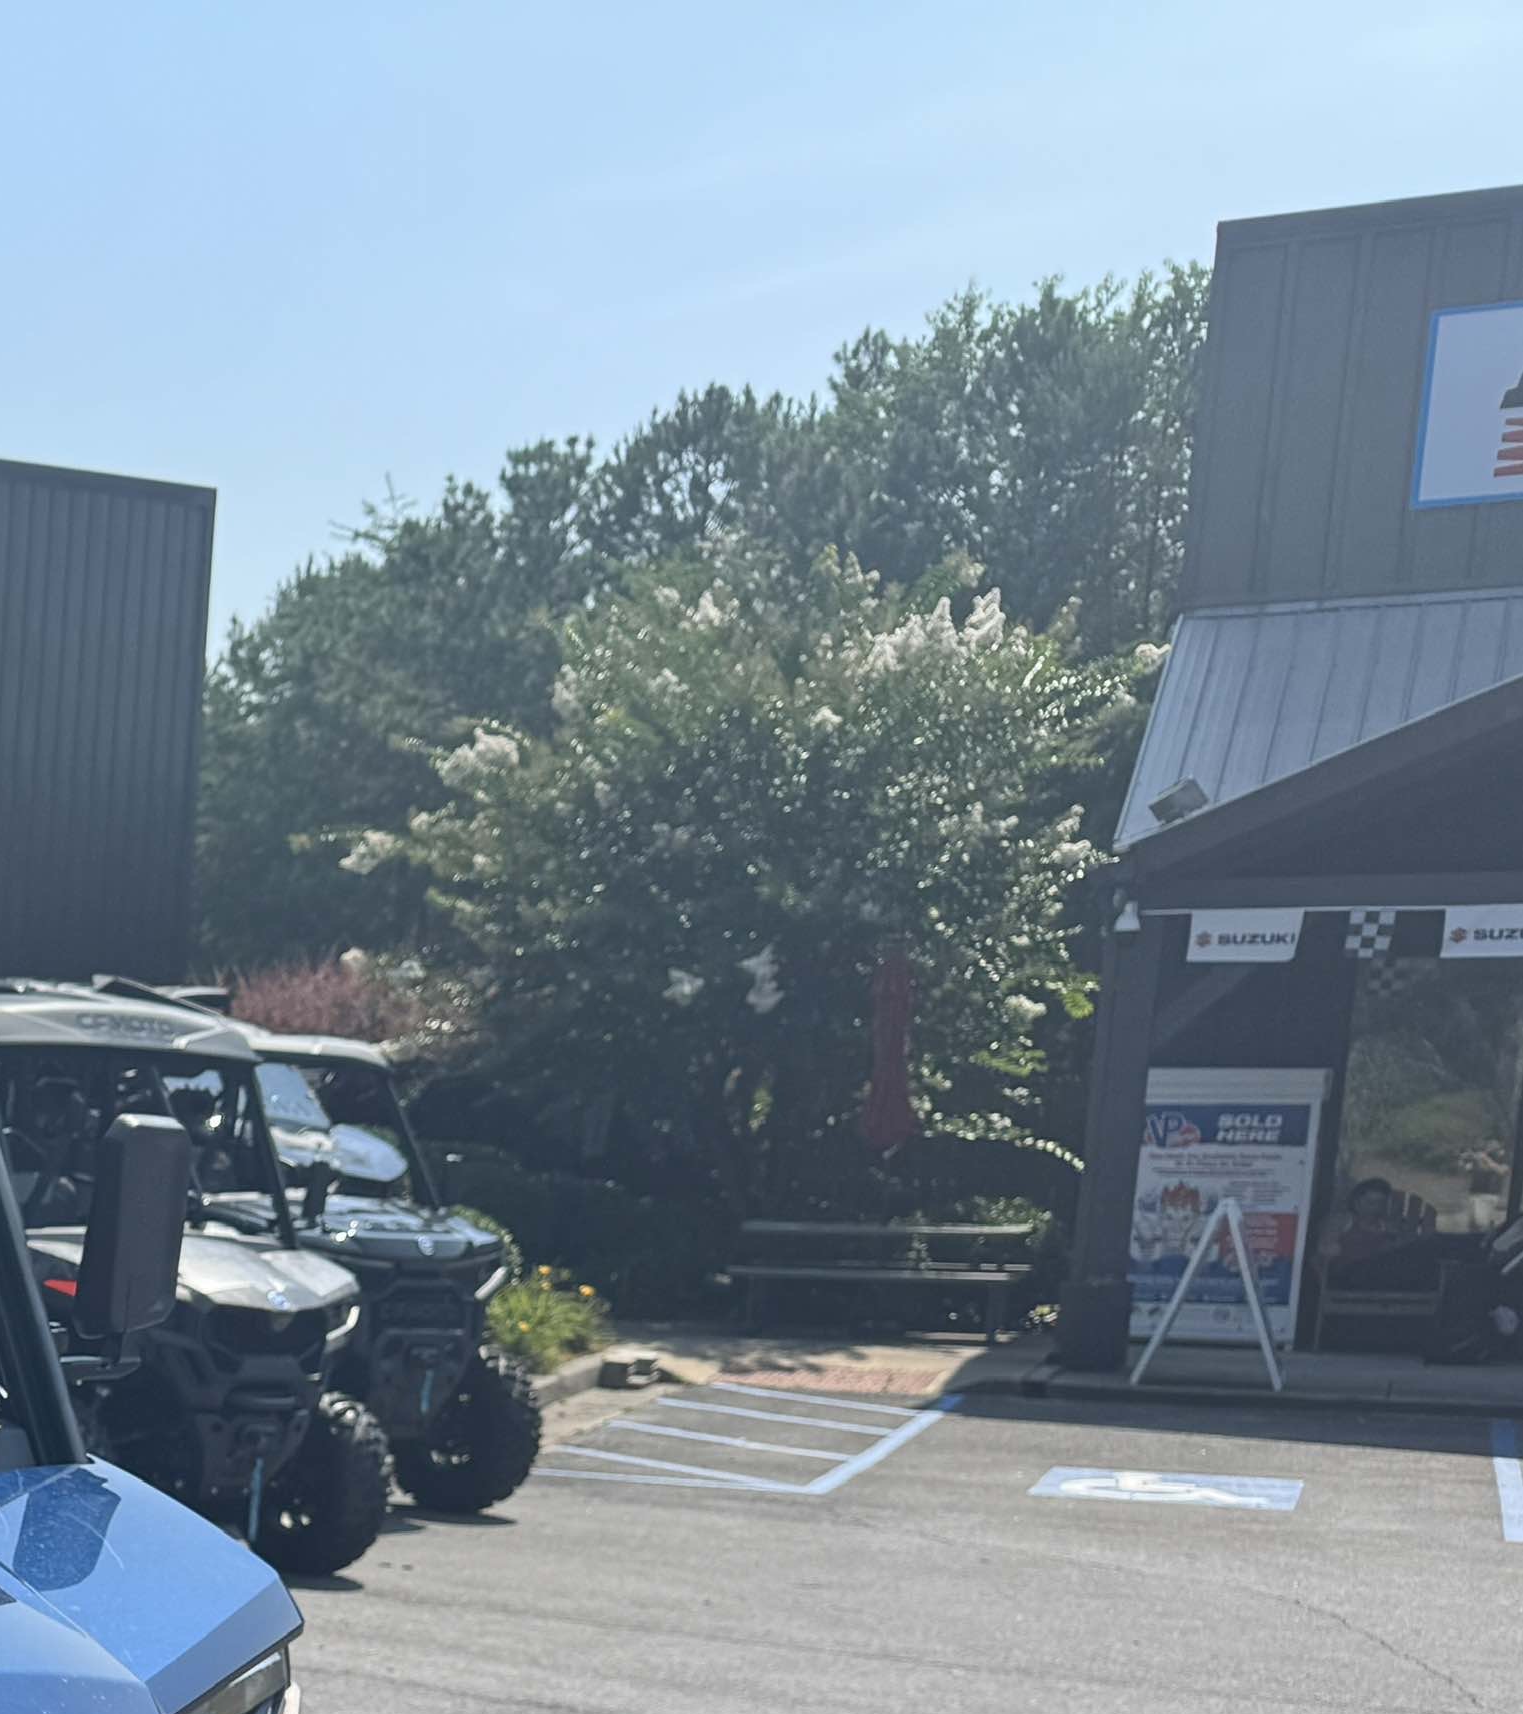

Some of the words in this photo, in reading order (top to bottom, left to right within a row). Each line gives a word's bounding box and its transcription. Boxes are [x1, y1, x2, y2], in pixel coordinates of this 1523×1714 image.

[1217, 932, 1295, 945] SUZUKI
[1474, 928, 1523, 940] SUZ
[1218, 1113, 1283, 1128] SOLD
[1216, 1129, 1281, 1142] HERE
